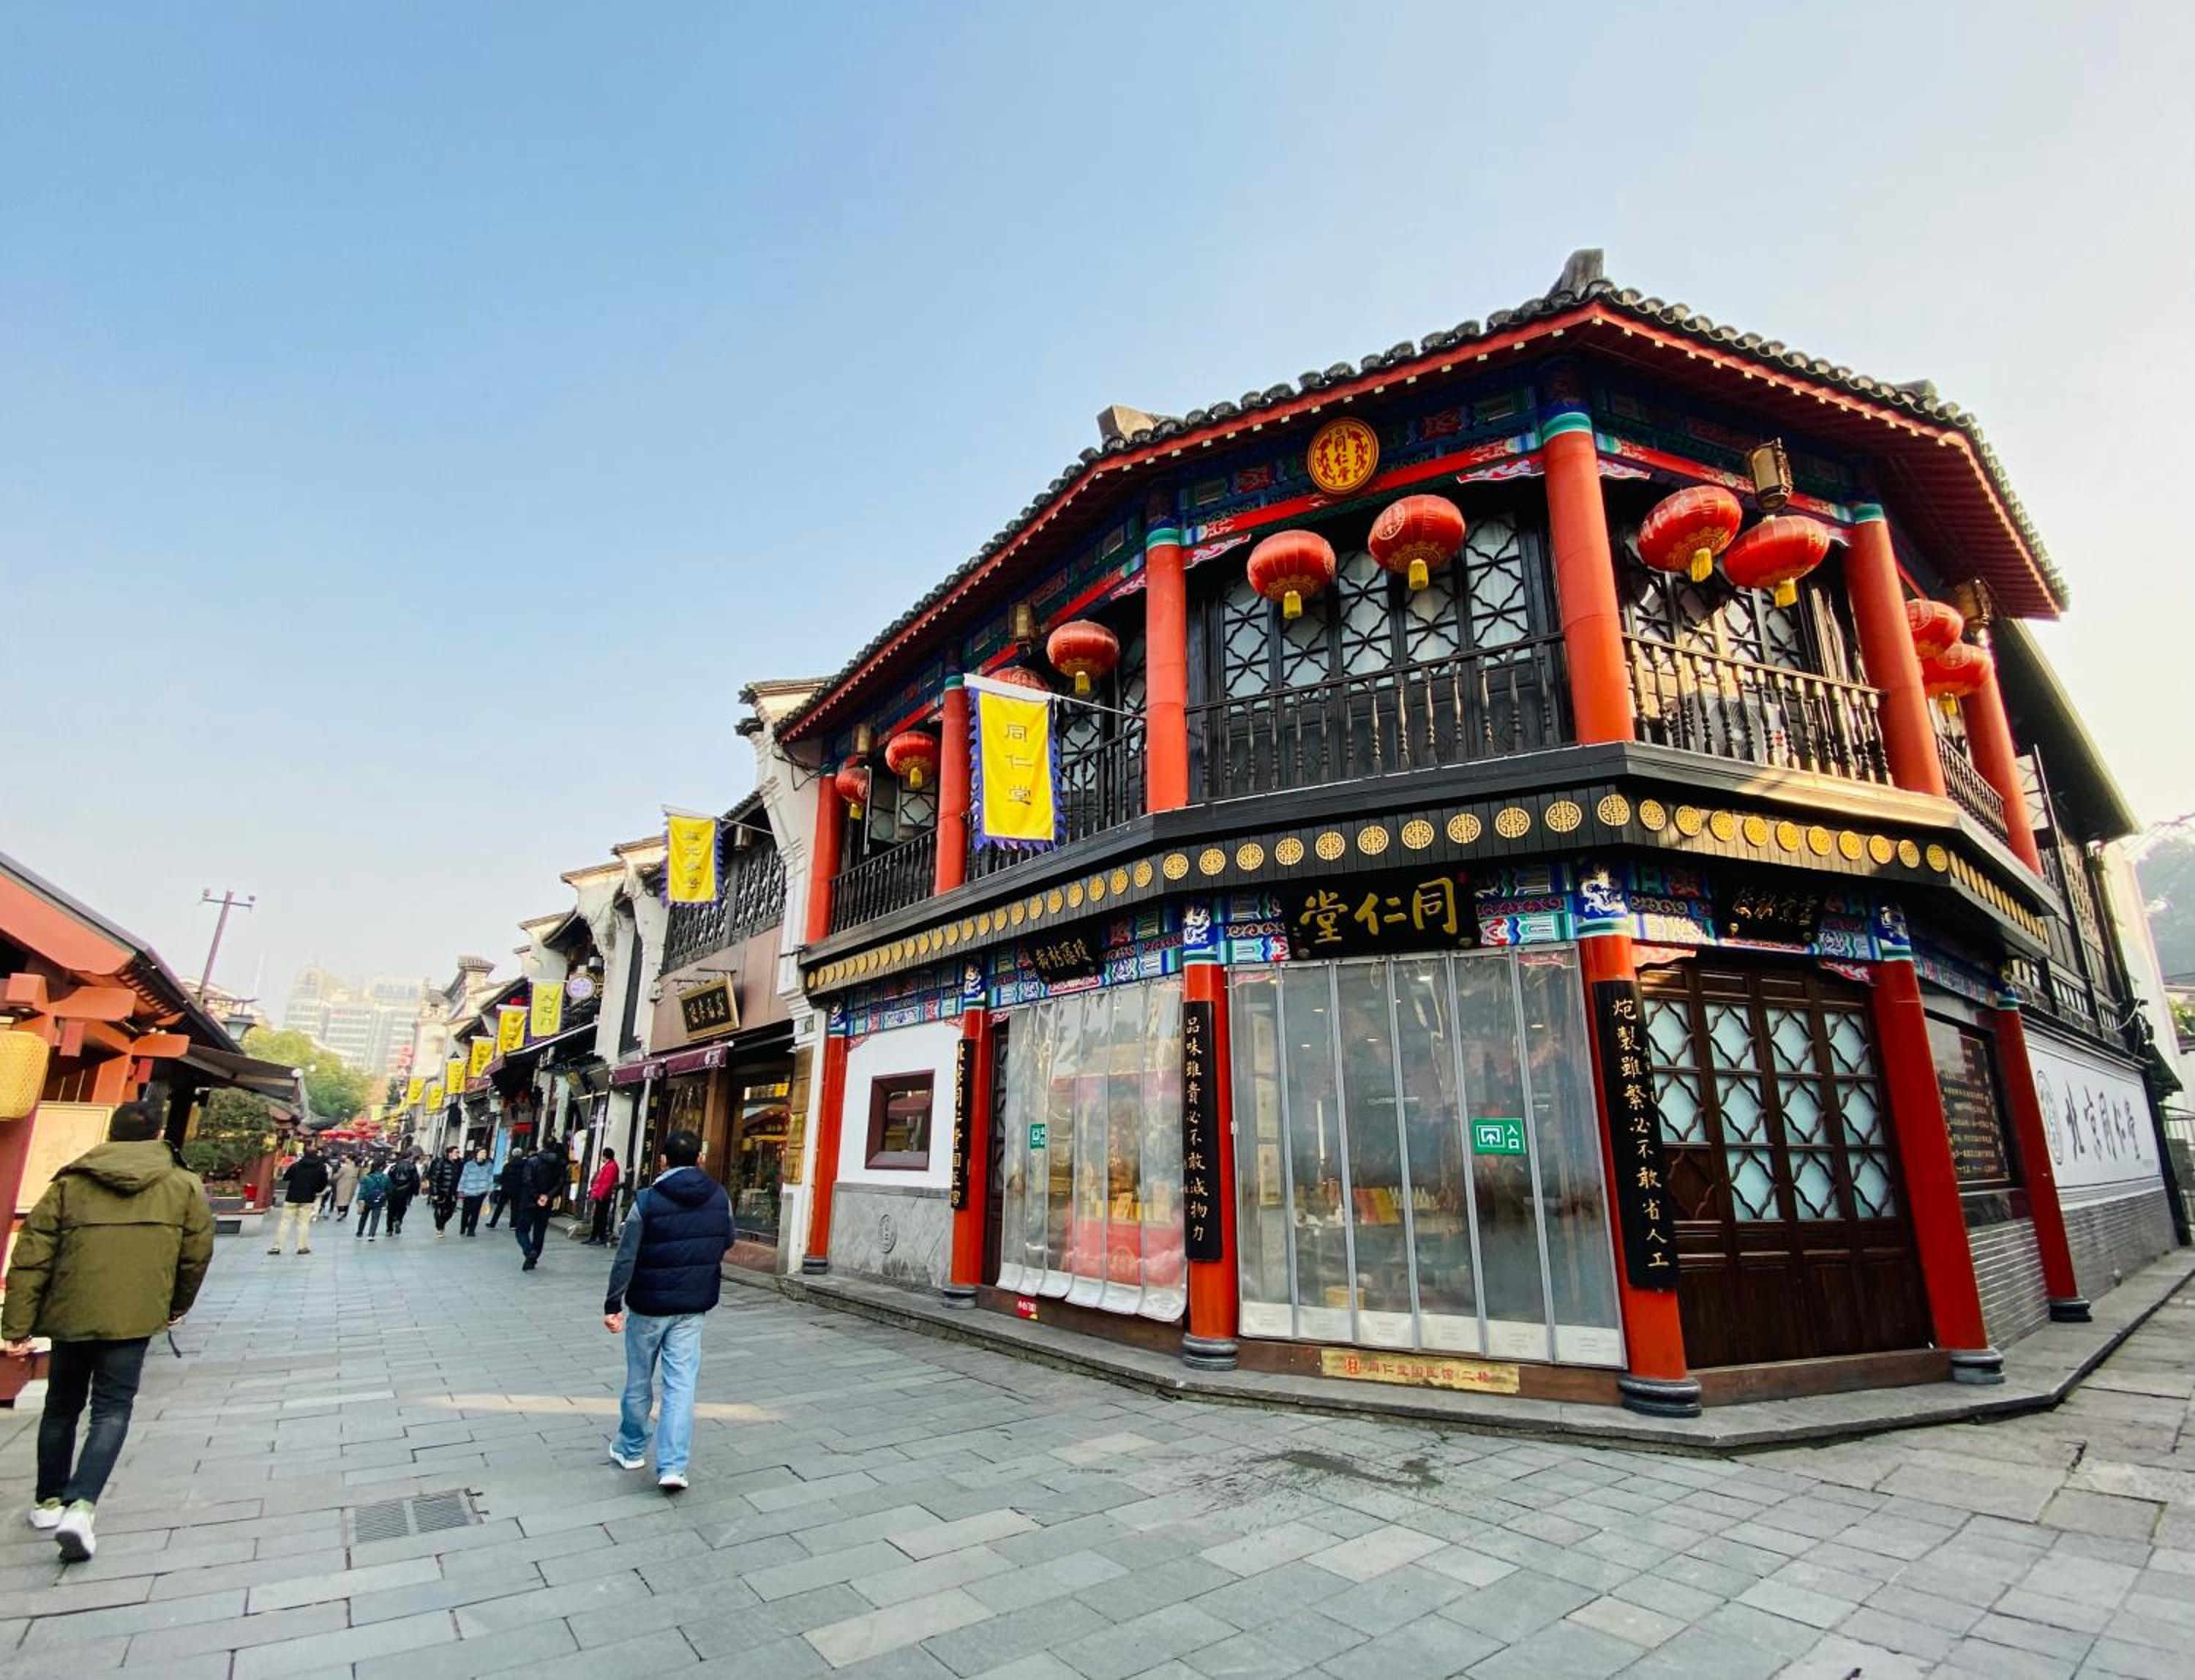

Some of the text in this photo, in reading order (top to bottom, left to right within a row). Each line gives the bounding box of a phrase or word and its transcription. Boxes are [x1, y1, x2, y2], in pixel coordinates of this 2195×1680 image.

[1299, 876, 1459, 945] 同仁堂
[1507, 1124, 1520, 1150] 入口
[1613, 998, 1670, 1267] 炮製雖繁必不敢省人工
